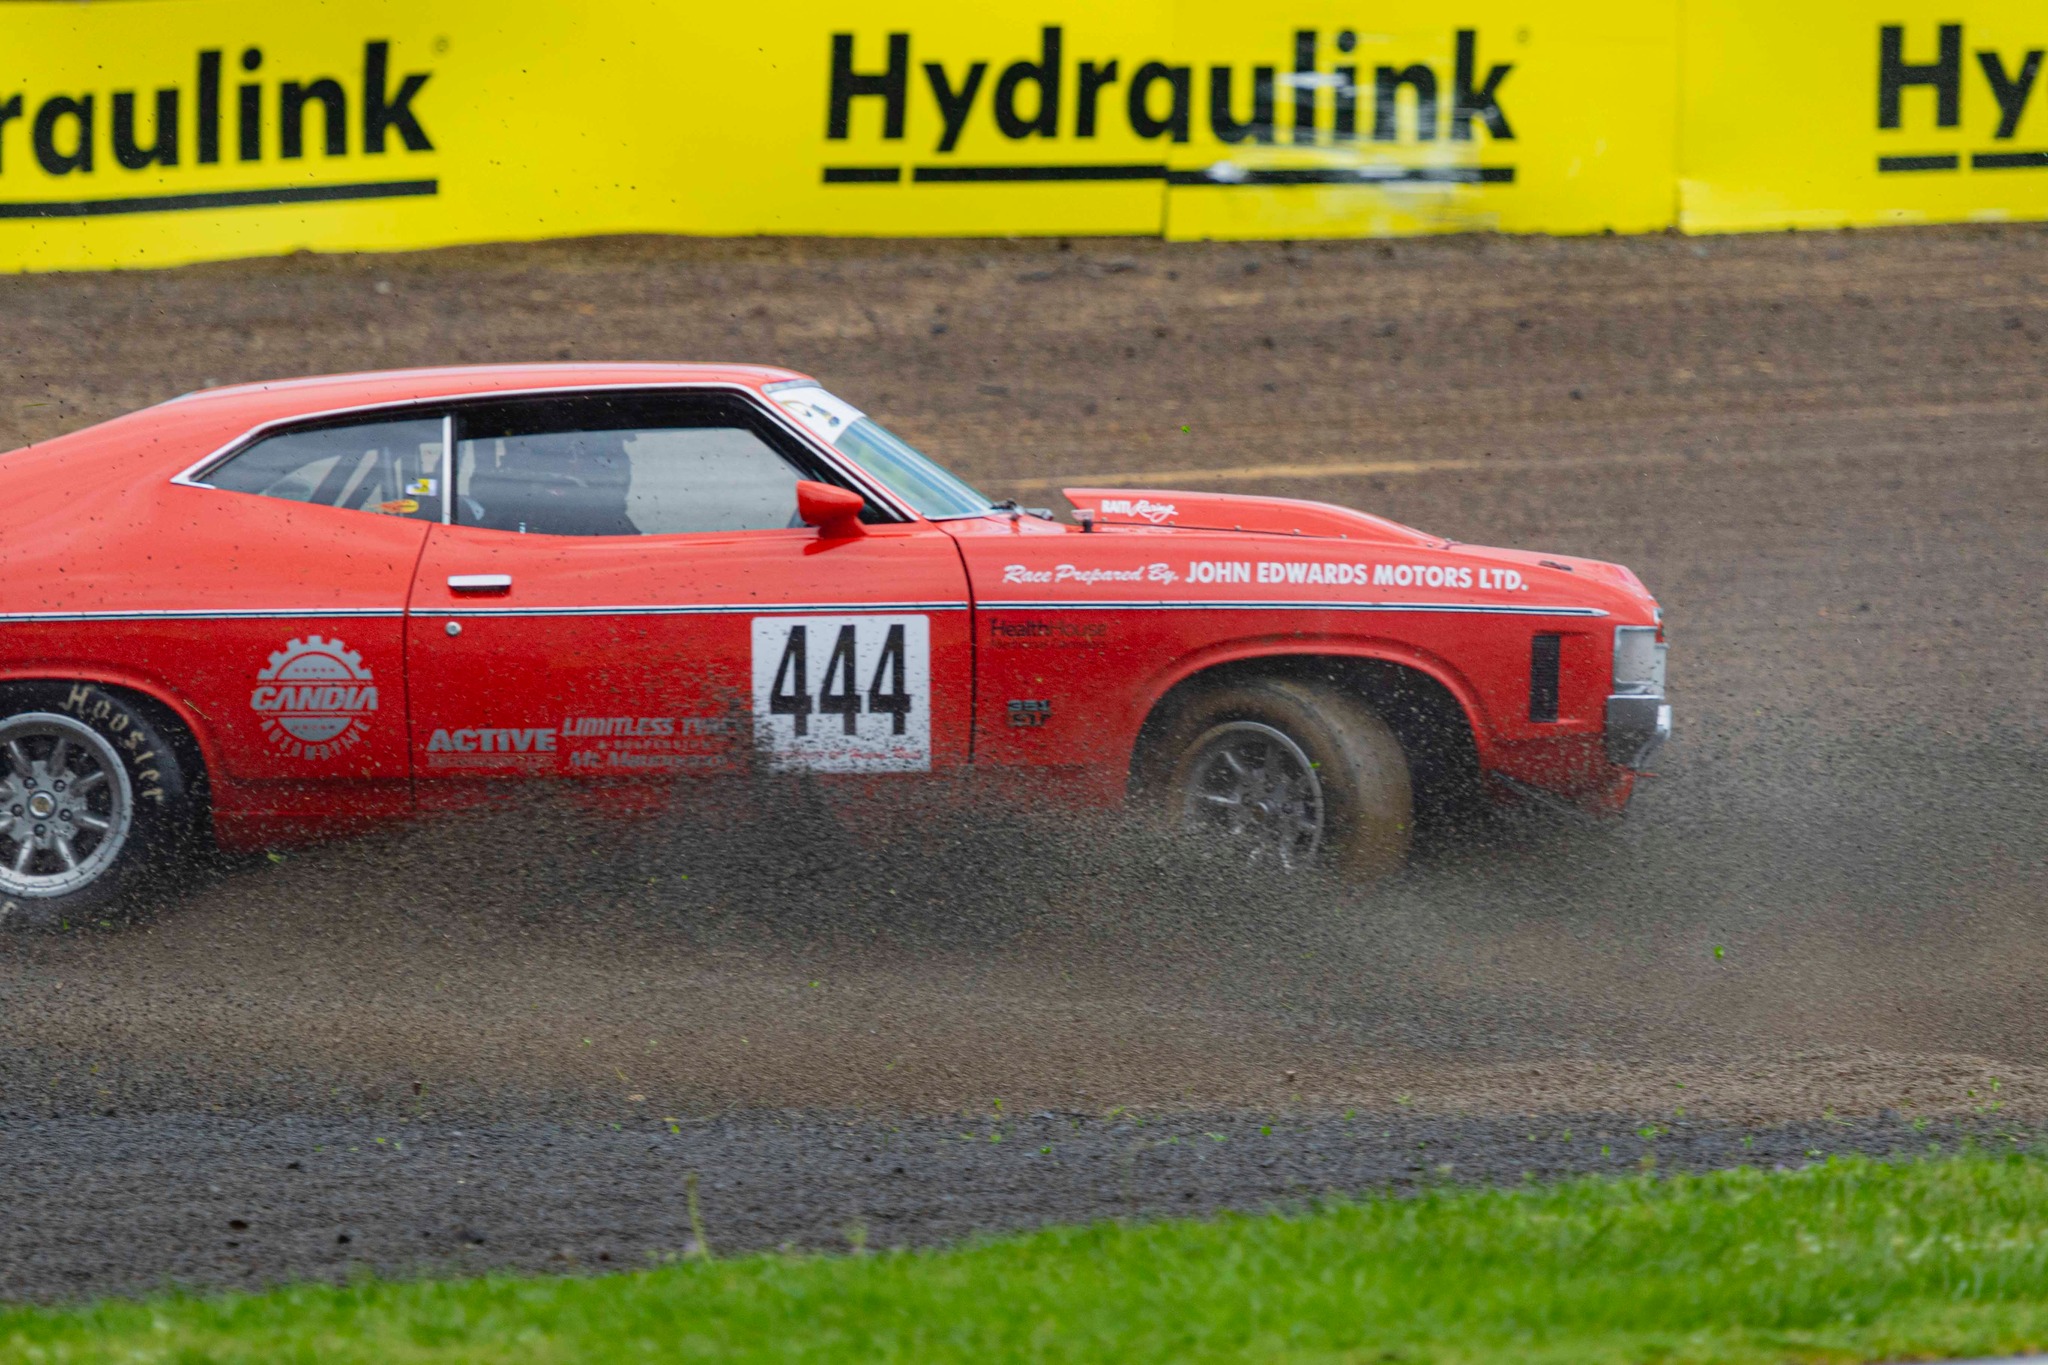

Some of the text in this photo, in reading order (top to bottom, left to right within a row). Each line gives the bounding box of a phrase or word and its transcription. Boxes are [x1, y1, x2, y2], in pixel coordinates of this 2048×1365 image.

[824, 24, 1518, 152] Hydraulink
[1002, 564, 1052, 584] Race
[1054, 563, 1145, 586] Prepared
[1185, 561, 1251, 583] JOHN
[1256, 562, 1368, 585] EDWARDS
[1373, 564, 1473, 588] MOTORS
[1478, 568, 1530, 591] LTD.
[770, 624, 912, 737] 444
[427, 728, 558, 752] ACTIVE
[561, 717, 675, 737] LIMITLESS
